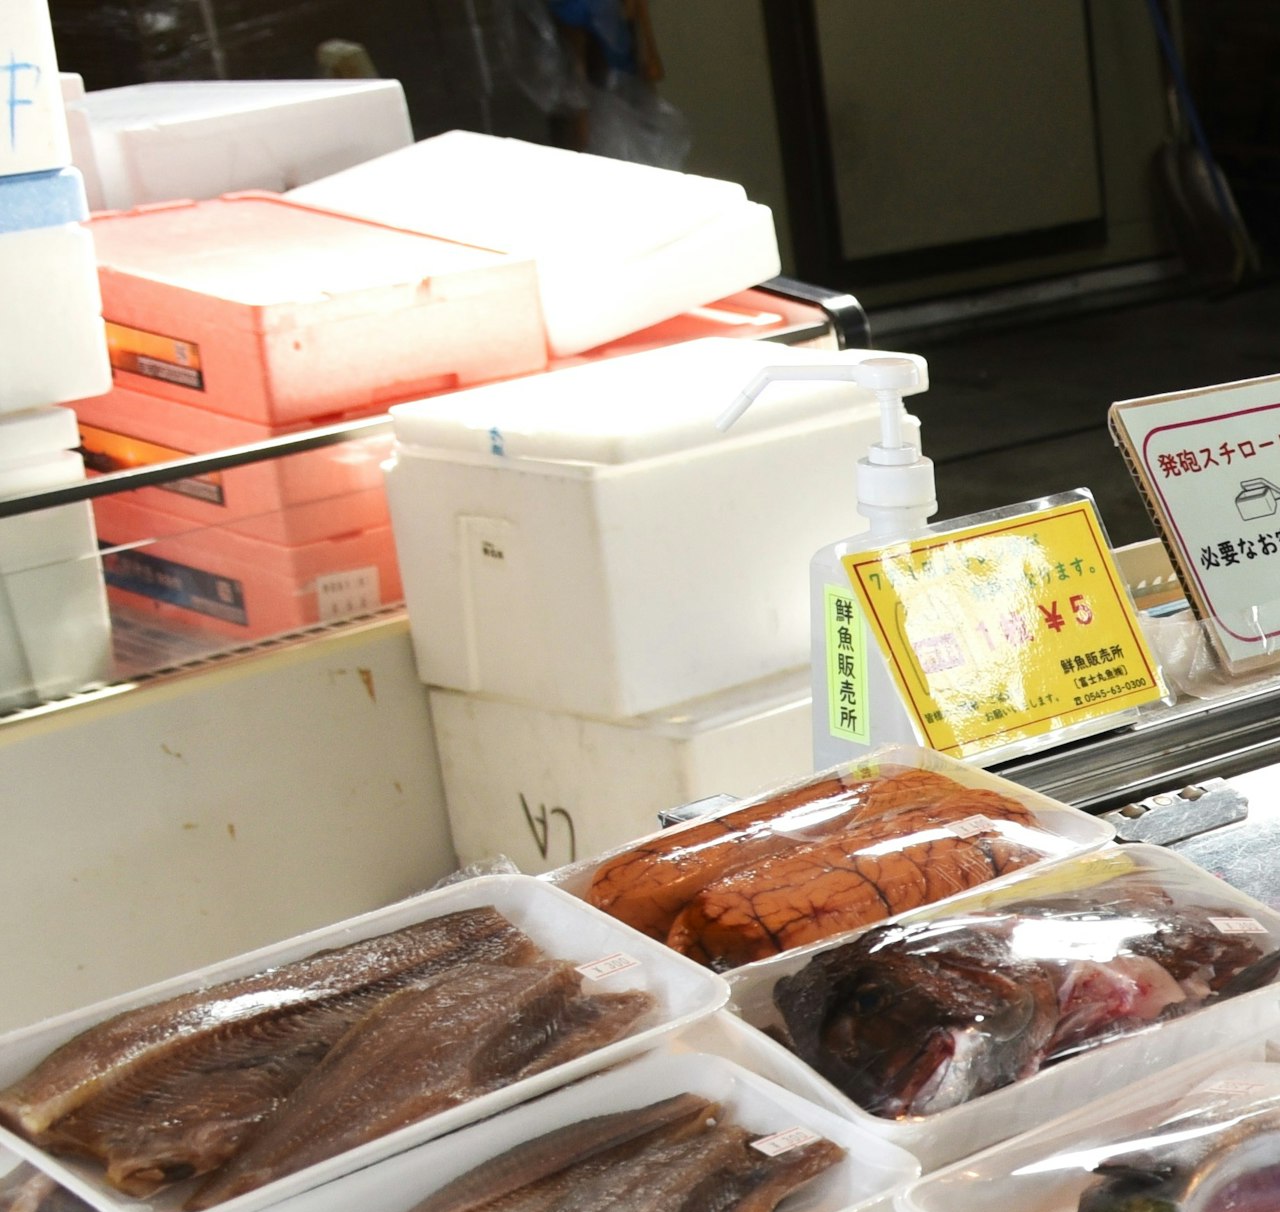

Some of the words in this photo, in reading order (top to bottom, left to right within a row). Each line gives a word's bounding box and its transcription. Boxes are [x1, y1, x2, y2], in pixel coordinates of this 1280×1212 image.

[834, 598, 858, 732] 鮮魚販売所
[1060, 645, 1125, 674] 鮮魚販売所
[1084, 677, 1147, 703] 0545-63-0300
